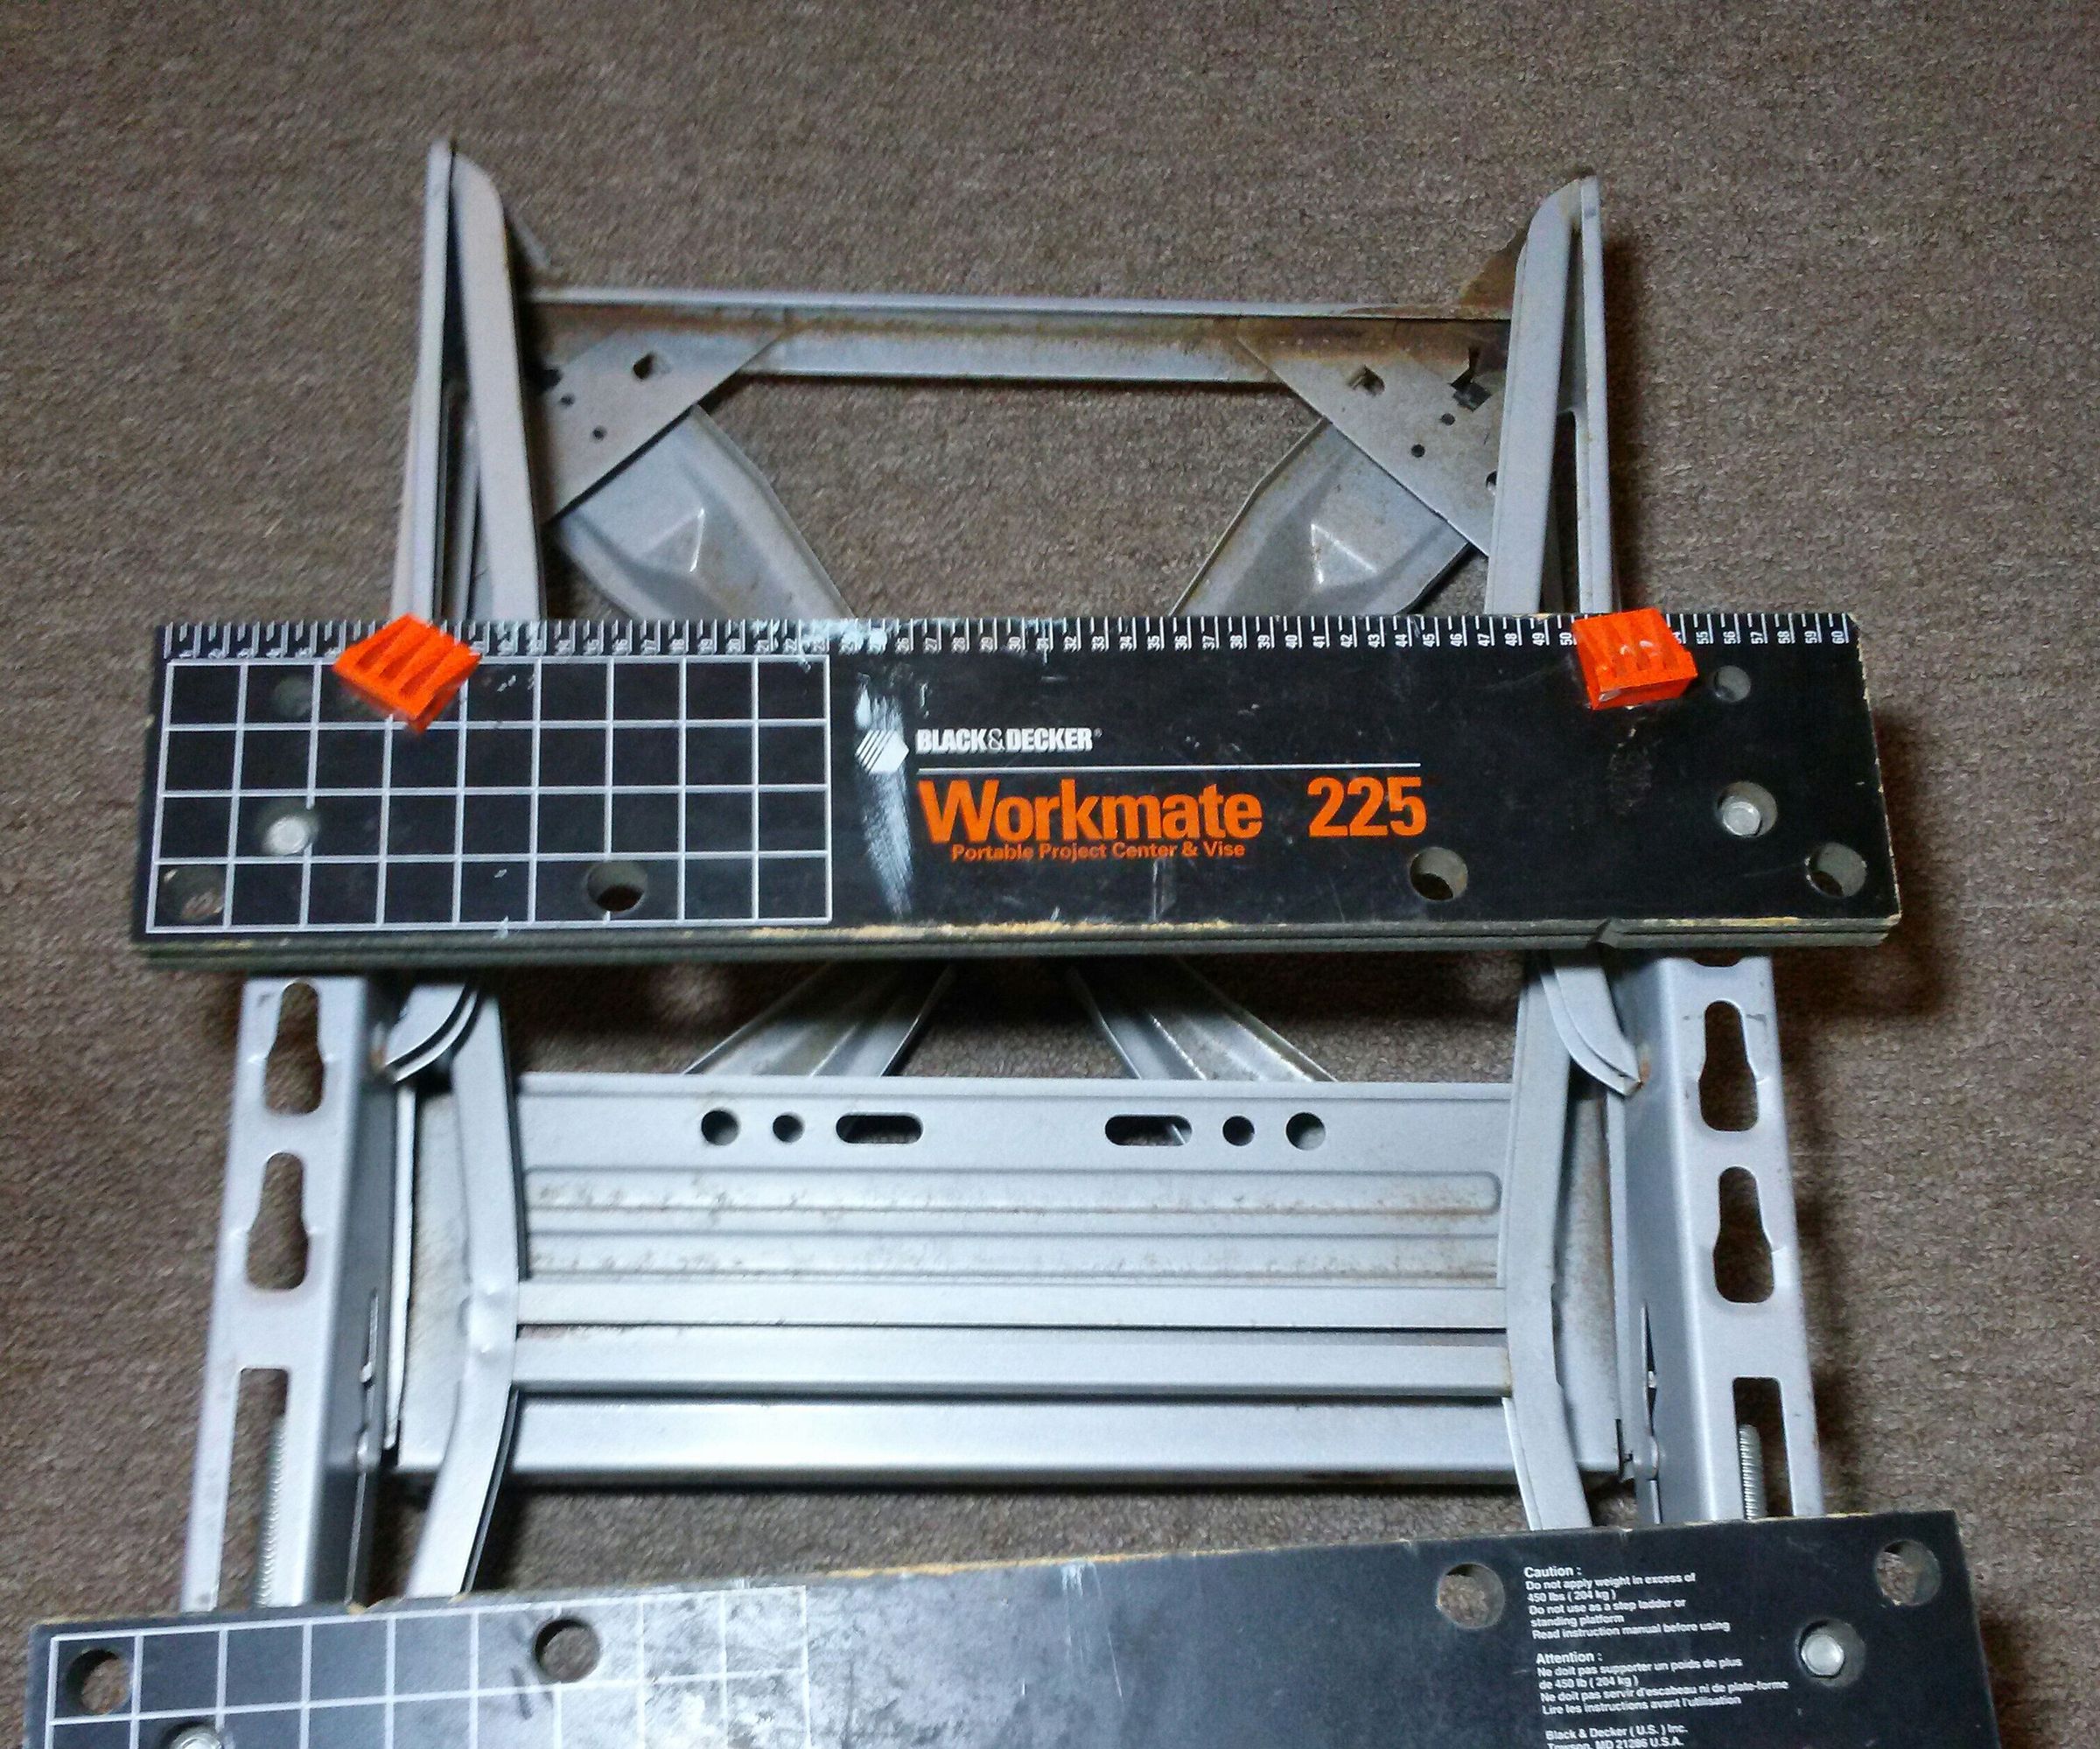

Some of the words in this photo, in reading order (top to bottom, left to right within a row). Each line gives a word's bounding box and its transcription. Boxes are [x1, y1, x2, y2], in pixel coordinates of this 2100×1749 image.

[979, 636, 994, 653] 29
[1007, 636, 1022, 653] 30
[1063, 635, 1078, 653] 32
[1090, 635, 1105, 653] 33
[1118, 635, 1132, 652] 34
[1146, 635, 1160, 651] 35
[1173, 635, 1187, 651] 36
[1201, 635, 1215, 650] 37
[1229, 634, 1242, 650] 38
[1256, 634, 1270, 650] 39
[1284, 634, 1298, 649] 40
[1312, 635, 1326, 649] 41
[1340, 634, 1353, 649] 42
[1367, 634, 1380, 648] 43
[1395, 633, 1408, 648] 44
[1422, 633, 1435, 647] 45
[1450, 633, 1463, 647] 46
[1477, 633, 1490, 647] 47
[1505, 633, 1517, 647] 48
[1532, 632, 1545, 647] 49
[1559, 632, 1572, 646] 50
[1696, 631, 1709, 645] 55
[1723, 631, 1736, 645] 56
[1751, 632, 1763, 645] 57
[1777, 631, 1790, 644] 58
[1805, 631, 1817, 644] 59
[1831, 631, 1844, 644] 60
[923, 637, 938, 654] 27
[919, 778, 1263, 843] Workmate
[1307, 776, 1428, 837] 225
[951, 844, 1034, 861] Portable
[1039, 843, 1107, 863] Project
[1111, 843, 1178, 859] Center
[1181, 841, 1199, 857] &
[1205, 840, 1245, 857] Vise
[1524, 1566, 1574, 1578] Caution
[1525, 1581, 1542, 1591] Do
[1543, 1580, 1562, 1589] not
[1563, 1578, 1592, 1590] apply
[1594, 1576, 1631, 1588] weight
[1632, 1576, 1643, 1585] in
[1645, 1575, 1683, 1585] excess
[1527, 1592, 1547, 1602] 450
[1548, 1592, 1566, 1602] lbs
[1573, 1591, 1593, 1601] 204
[1594, 1589, 1610, 1601] kg
[1528, 1605, 1545, 1615] Do
[1546, 1604, 1565, 1614] not
[1566, 1604, 1587, 1613] use
[1588, 1603, 1603, 1613] as
[1613, 1600, 1636, 1613] step
[1638, 1599, 1673, 1610] ladder
[1530, 1616, 1578, 1628] standing
[1578, 1613, 1625, 1627] platform
[1531, 1628, 1561, 1640] Read
[1562, 1627, 1620, 1639] instruction
[1621, 1623, 1662, 1635] manual
[1662, 1622, 1698, 1634] before
[1698, 1620, 1731, 1633] using
[1536, 1651, 1595, 1665] Attention
[1537, 1667, 1553, 1677] Ne
[1554, 1665, 1576, 1676] doit
[1577, 1666, 1599, 1677] pas
[1600, 1662, 1652, 1675] supporter
[1654, 1662, 1669, 1671] un
[1670, 1659, 1702, 1673] poids
[1702, 1658, 1717, 1669] de
[1718, 1657, 1744, 1669] plus
[1538, 1680, 1553, 1690] de
[1554, 1678, 1575, 1689] 450
[1575, 1677, 1588, 1688] lb
[1595, 1676, 1615, 1687] 204
[1616, 1676, 1633, 1688] kg
[1540, 1692, 1557, 1703] Ne
[1558, 1690, 1579, 1702] doit
[1580, 1691, 1602, 1703] pas
[1602, 1689, 1635, 1700] servir
[1635, 1685, 1698, 1697] d'escabeau
[1698, 1683, 1711, 1694] ni
[1711, 1683, 1726, 1693] de
[1726, 1680, 1789, 1695] plate-forme
[1541, 1704, 1564, 1715] Lire
[1564, 1704, 1583, 1714] les
[1583, 1702, 1649, 1713] instructions
[1649, 1698, 1681, 1710] avant
[1544, 1730, 1577, 1740] Black
[1578, 1729, 1588, 1739] &
[1589, 1726, 1628, 1739] Decker
[1635, 1725, 1660, 1736] U.S.
[1667, 1724, 1689, 1734] Inc.
[1594, 1740, 1614, 1749] MD
[1649, 1736, 1685, 1747] U.S.A.
